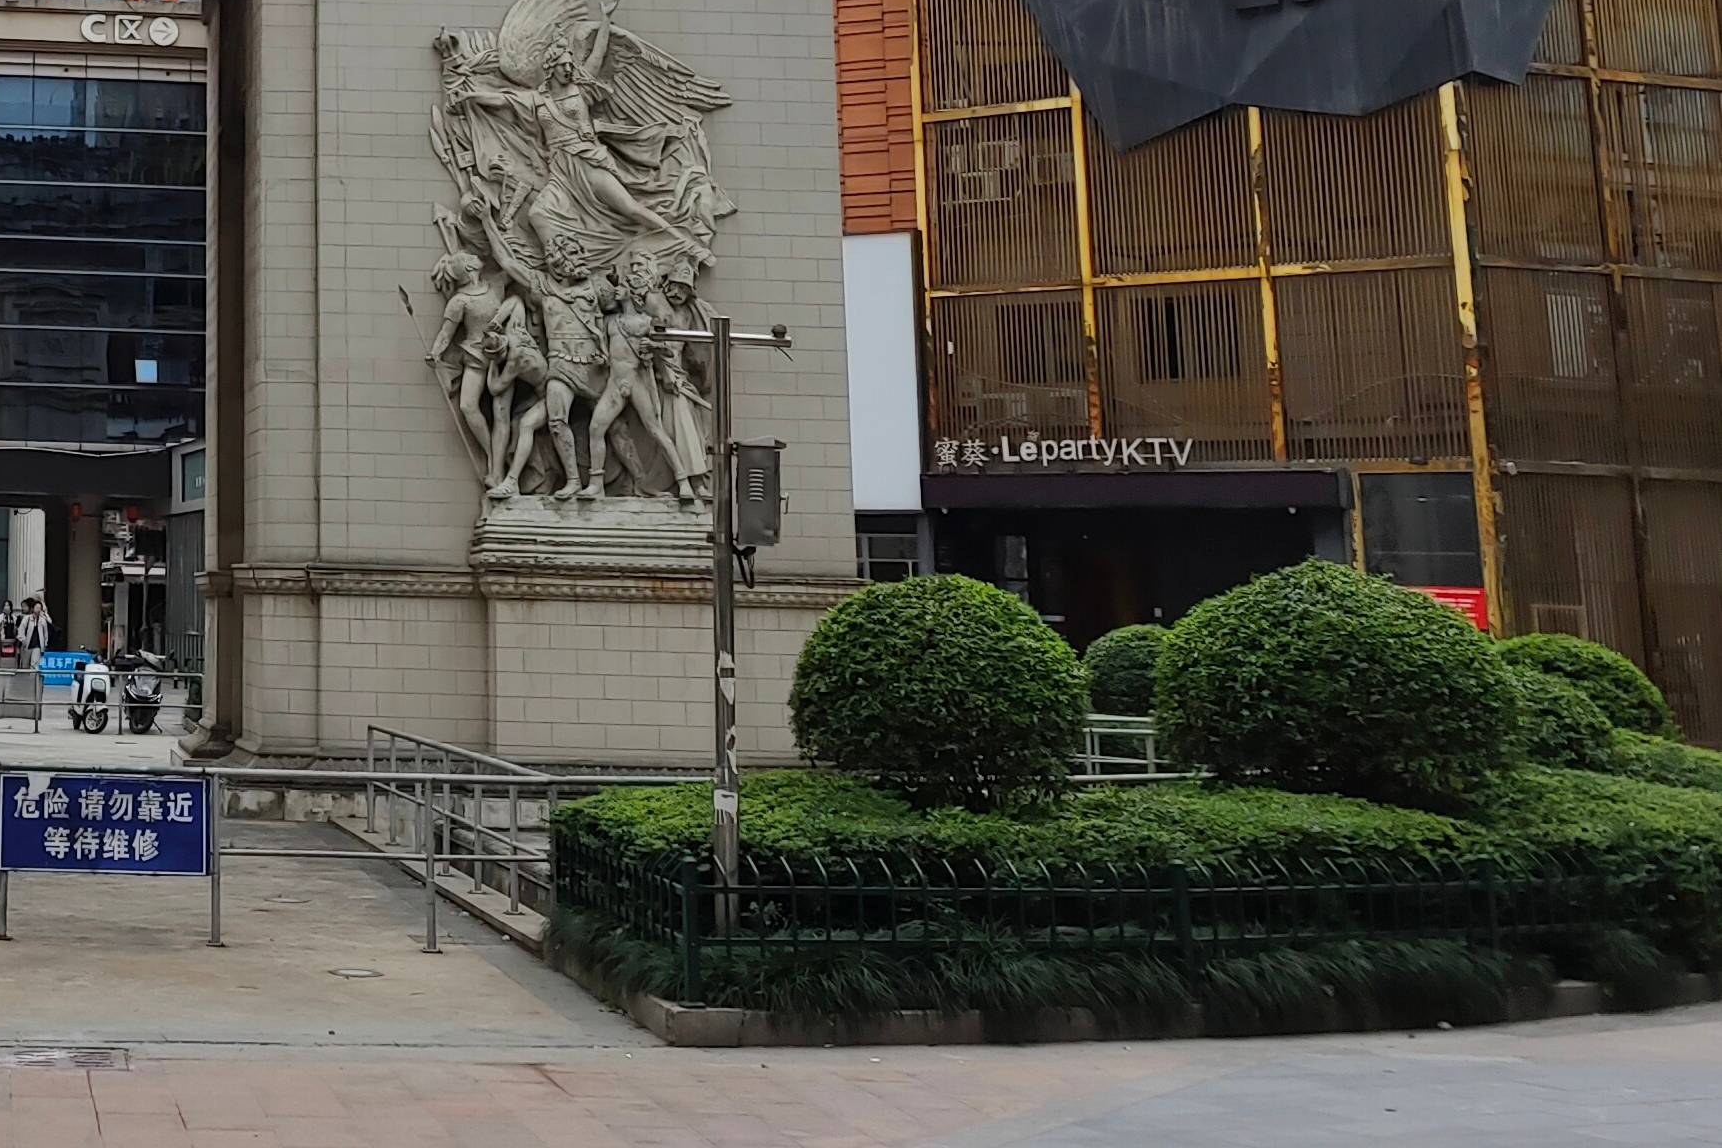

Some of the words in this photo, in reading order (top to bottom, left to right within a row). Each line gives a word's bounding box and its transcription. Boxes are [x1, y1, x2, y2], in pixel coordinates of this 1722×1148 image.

[80, 14, 144, 44] C区
[78, 788, 194, 823] 请勿靠近
[43, 826, 160, 862] 等待维修
